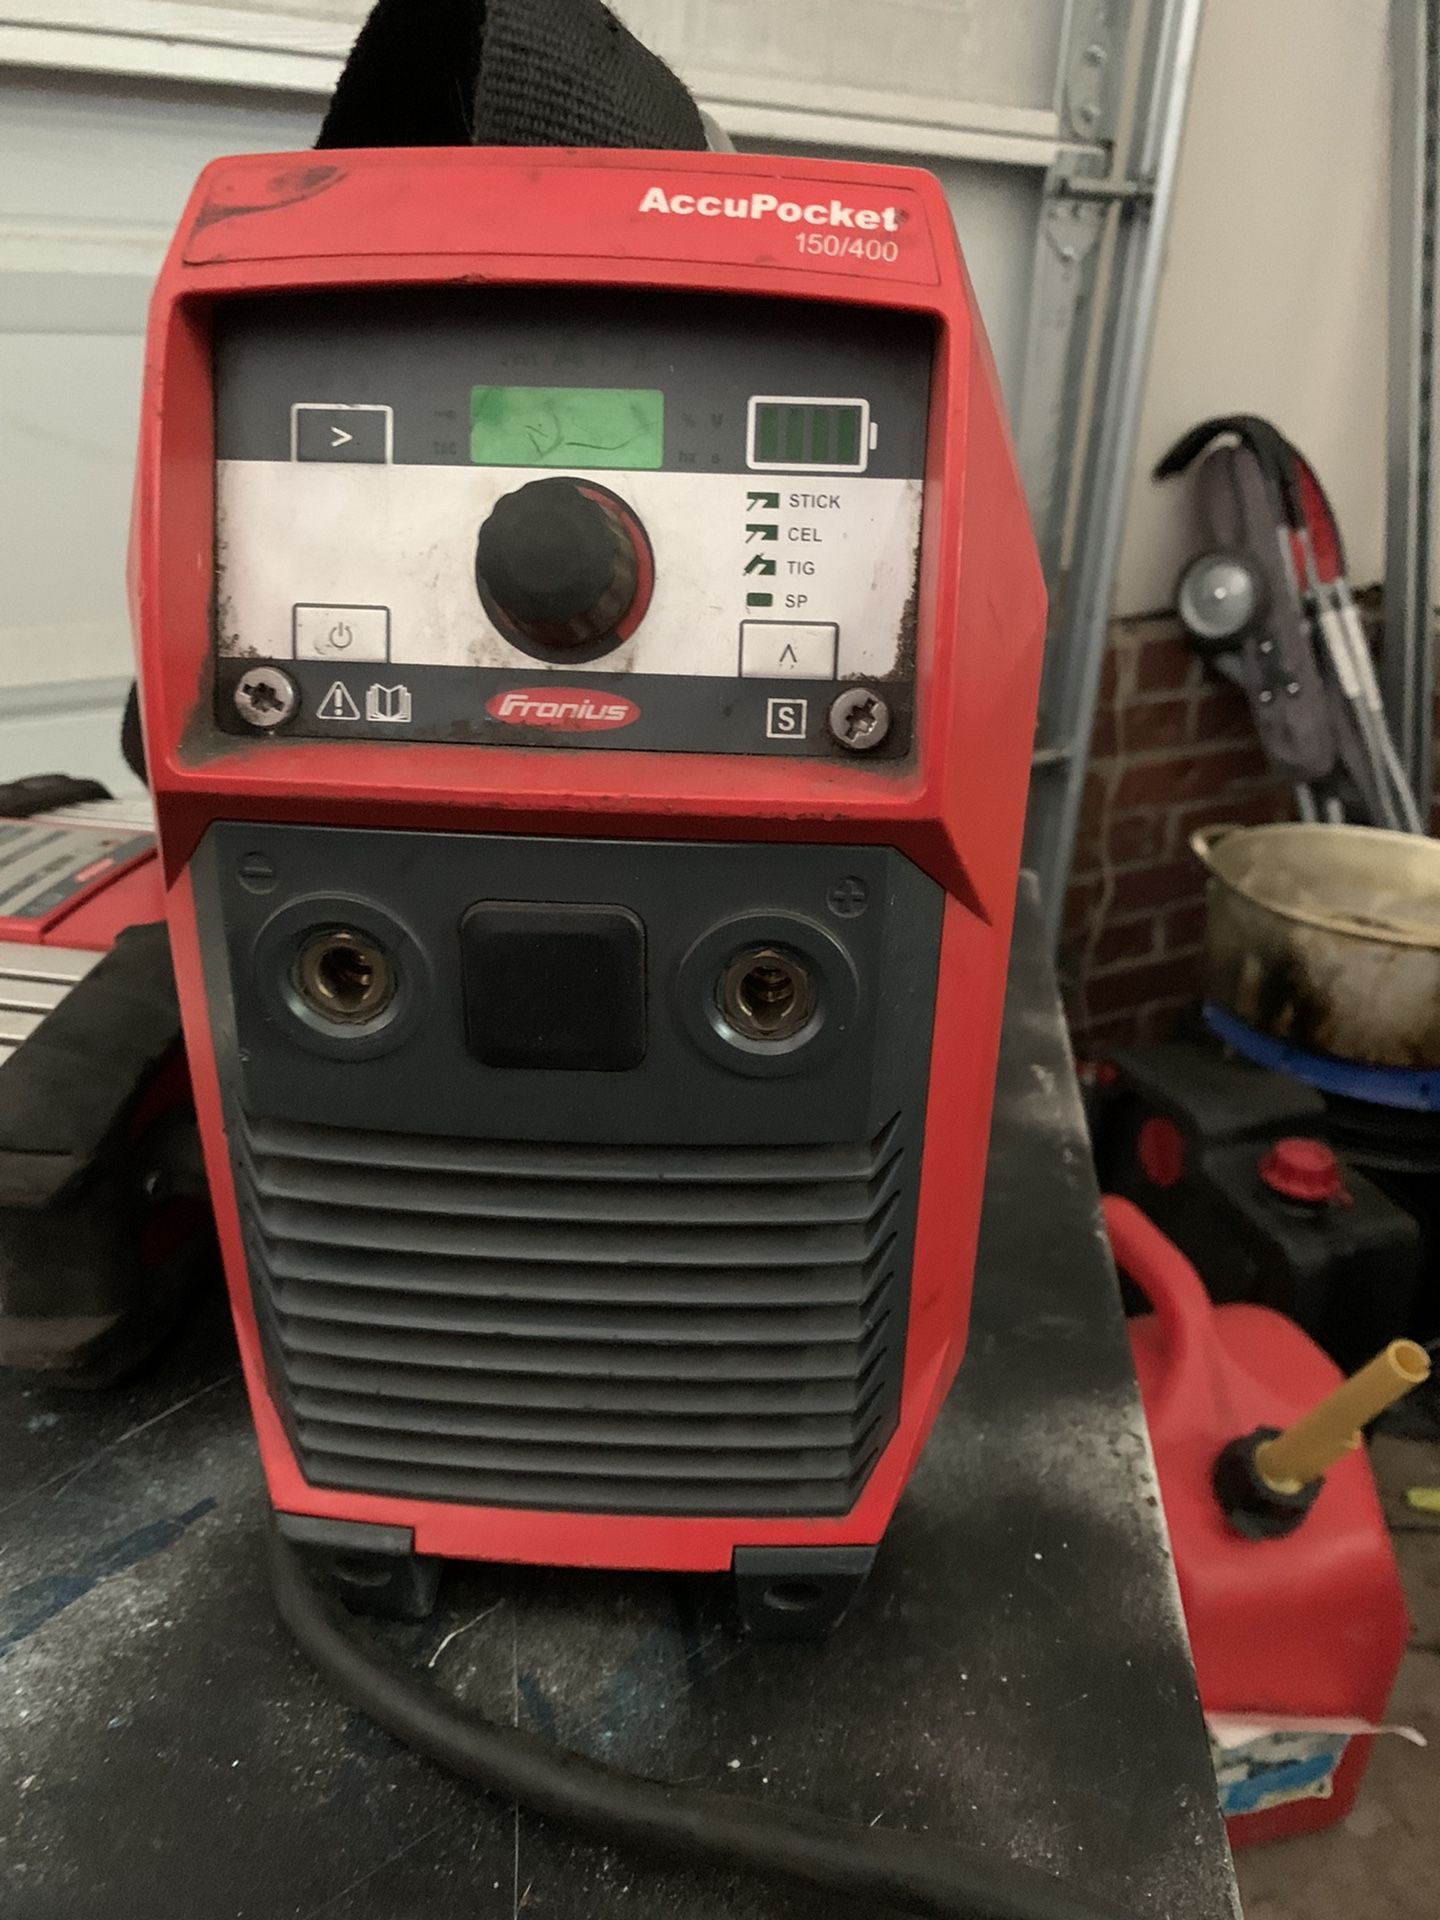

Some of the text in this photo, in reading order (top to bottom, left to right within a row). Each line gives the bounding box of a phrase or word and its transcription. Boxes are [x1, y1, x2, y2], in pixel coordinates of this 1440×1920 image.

[638, 186, 899, 232] AccuPocket
[795, 232, 899, 262] 150/400
[789, 493, 841, 510] STICK
[787, 527, 823, 542] CEL
[787, 560, 815, 576] TIG
[785, 593, 808, 609] SP
[498, 693, 629, 721] Fronius
[778, 706, 796, 731] S
